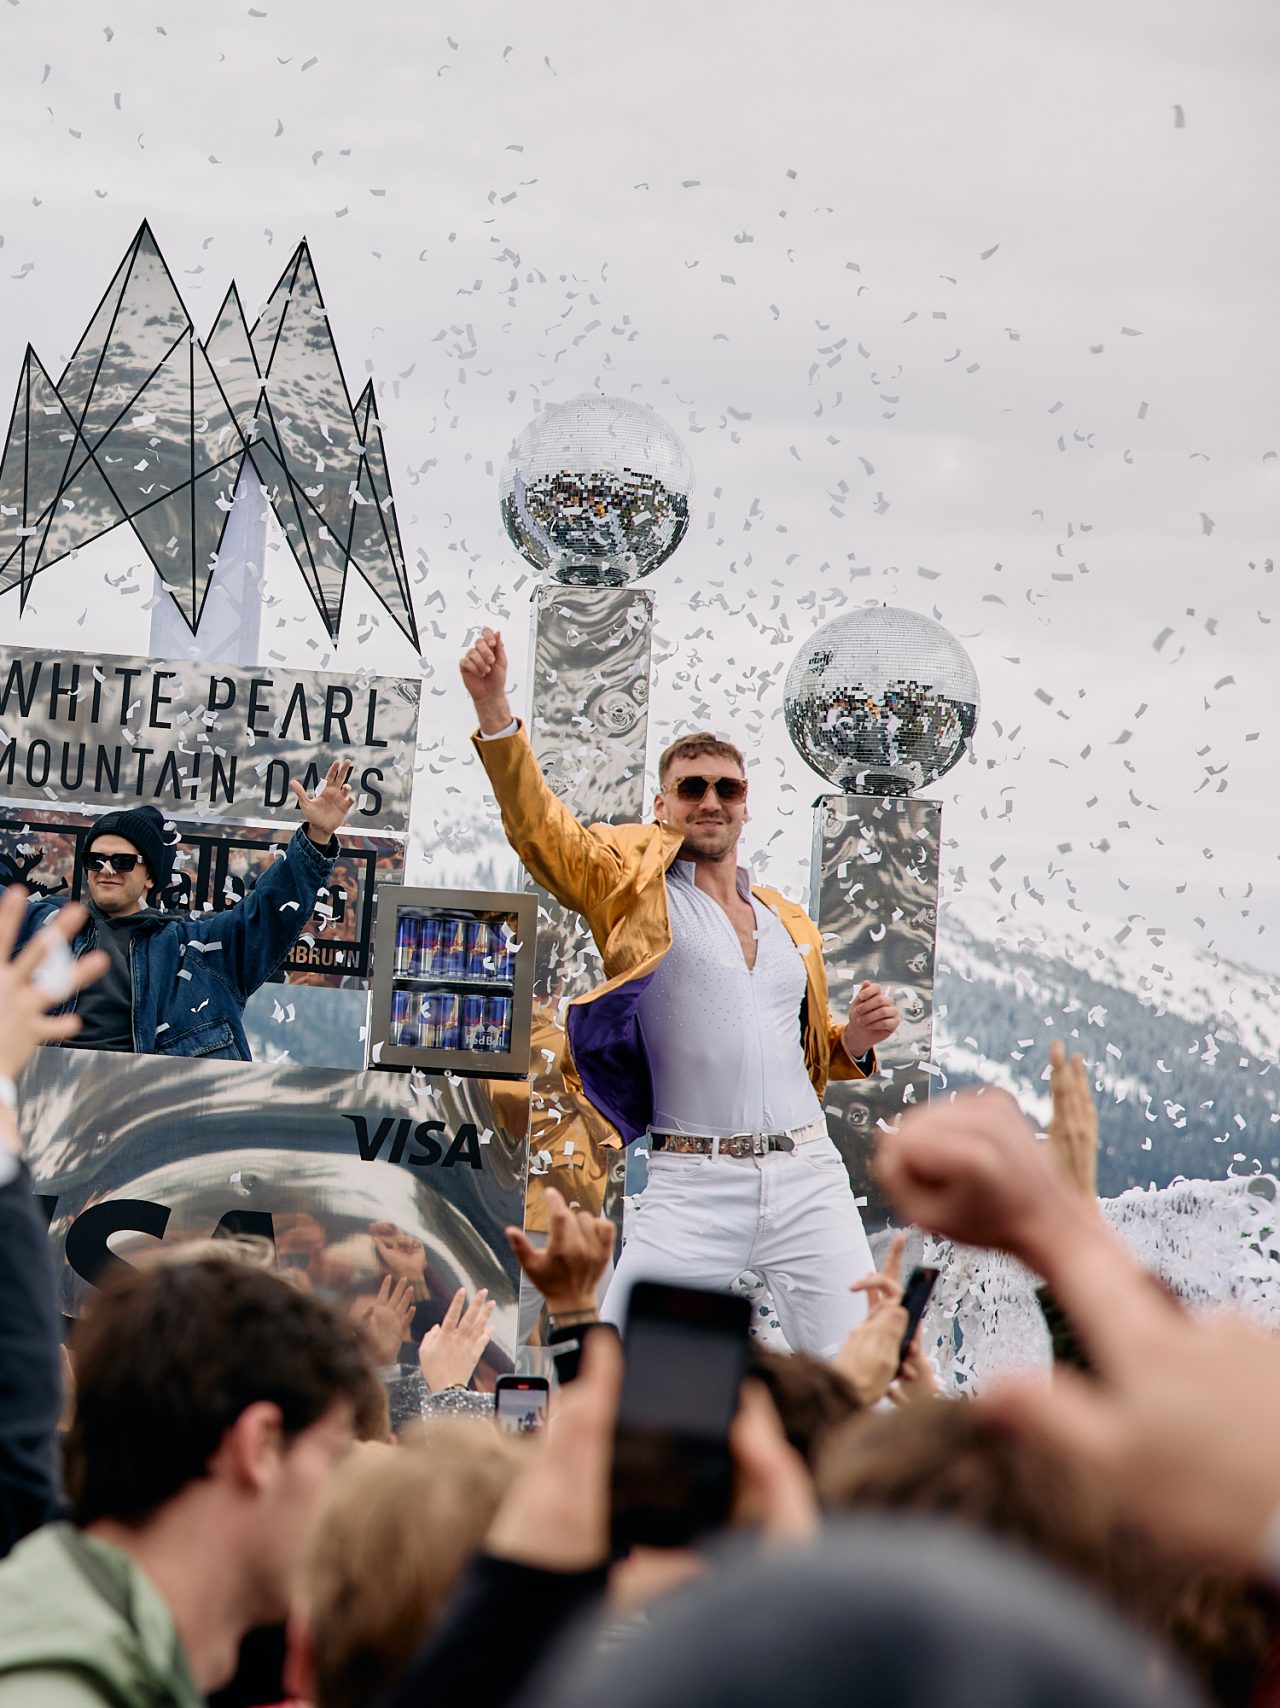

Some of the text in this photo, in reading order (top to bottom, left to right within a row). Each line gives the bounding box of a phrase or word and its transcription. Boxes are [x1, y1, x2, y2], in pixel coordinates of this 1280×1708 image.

[206, 675, 389, 748] PEARL
[263, 759, 384, 817] DAS
[341, 1114, 483, 1170] VISA
